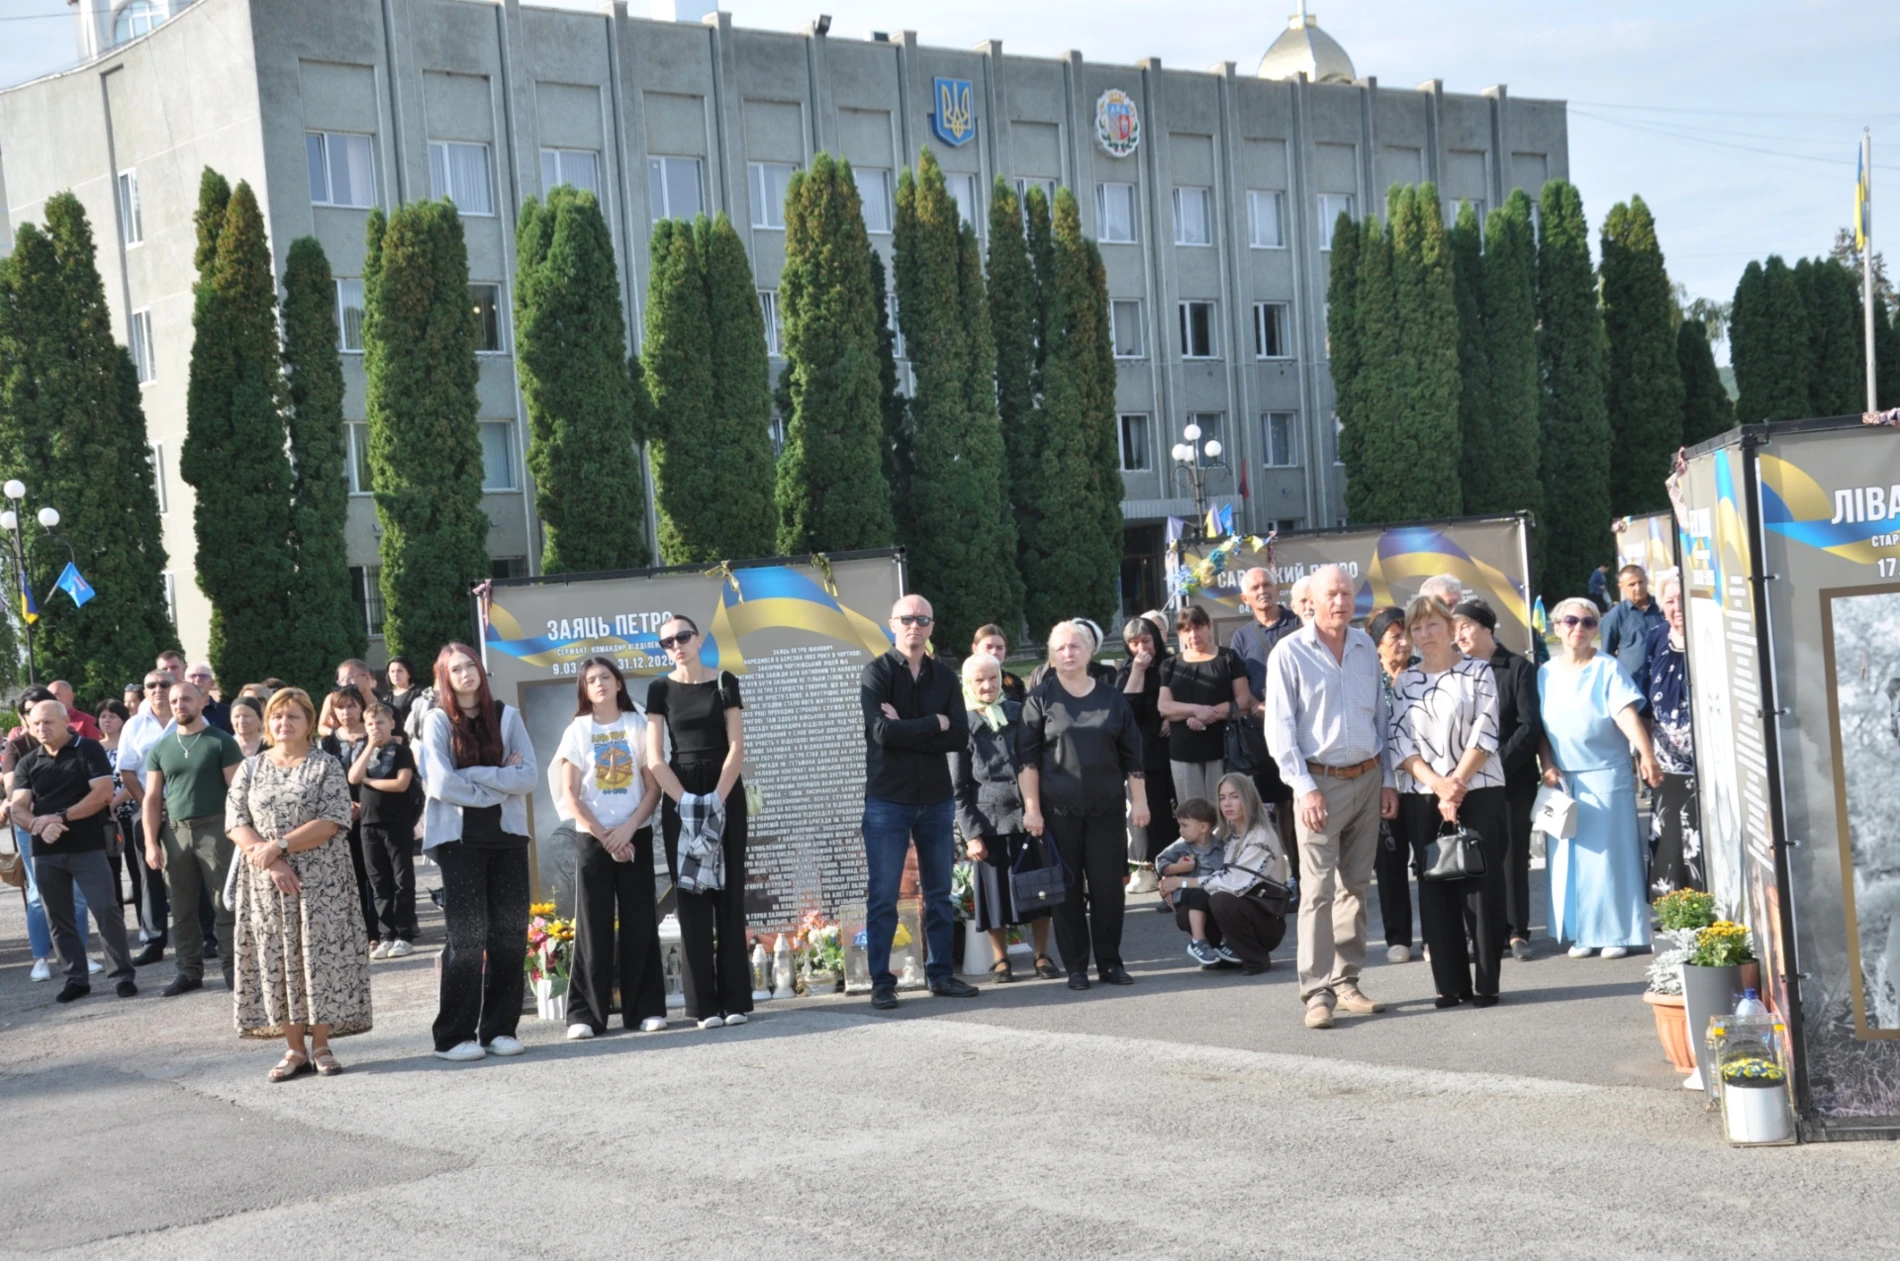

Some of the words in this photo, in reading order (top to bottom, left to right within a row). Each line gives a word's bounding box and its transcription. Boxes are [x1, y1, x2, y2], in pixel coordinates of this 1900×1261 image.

[1872, 534, 1900, 547] СТАР
[547, 616, 610, 640] ЗАЯЦЬ
[592, 644, 626, 654] КОМАНДИР
